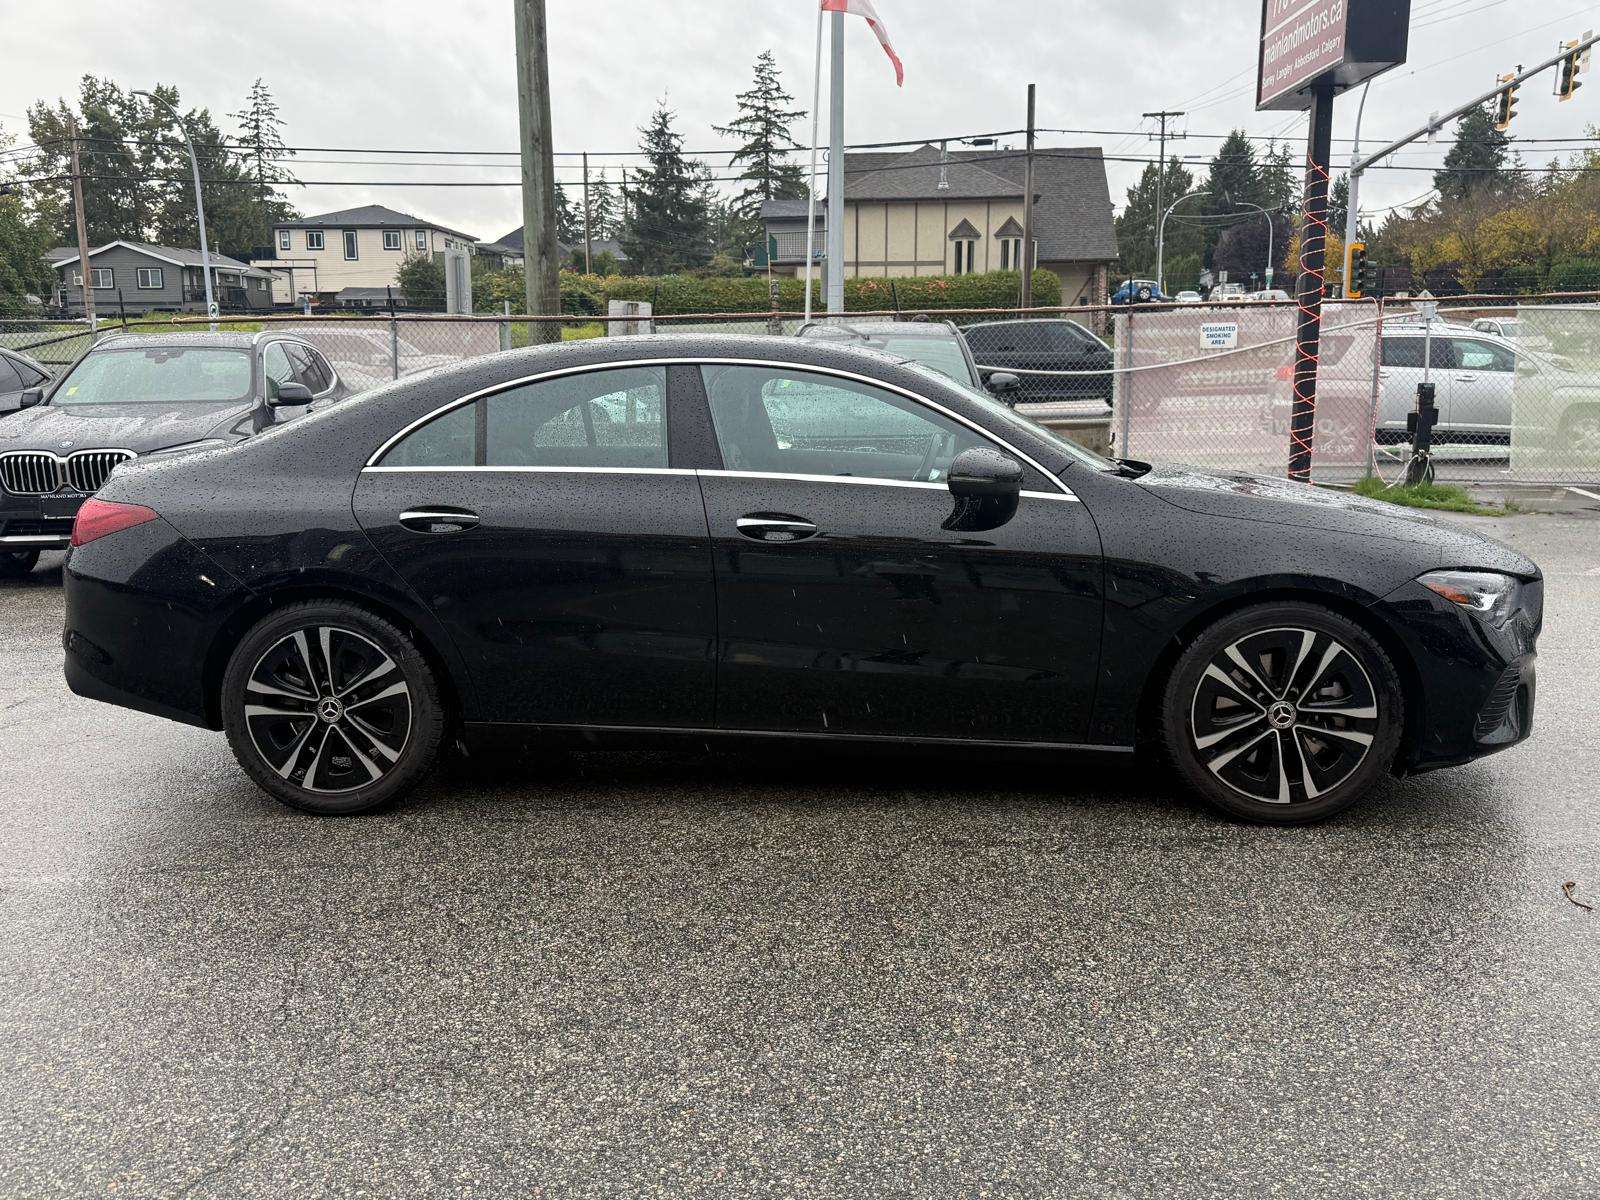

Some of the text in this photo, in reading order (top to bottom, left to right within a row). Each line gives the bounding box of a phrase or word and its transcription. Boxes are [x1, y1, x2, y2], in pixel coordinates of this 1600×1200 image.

[1262, 35, 1341, 88] Surrey Langley Abbotsford Calgary
[1264, 0, 1342, 67] mainlandmotors.ca
